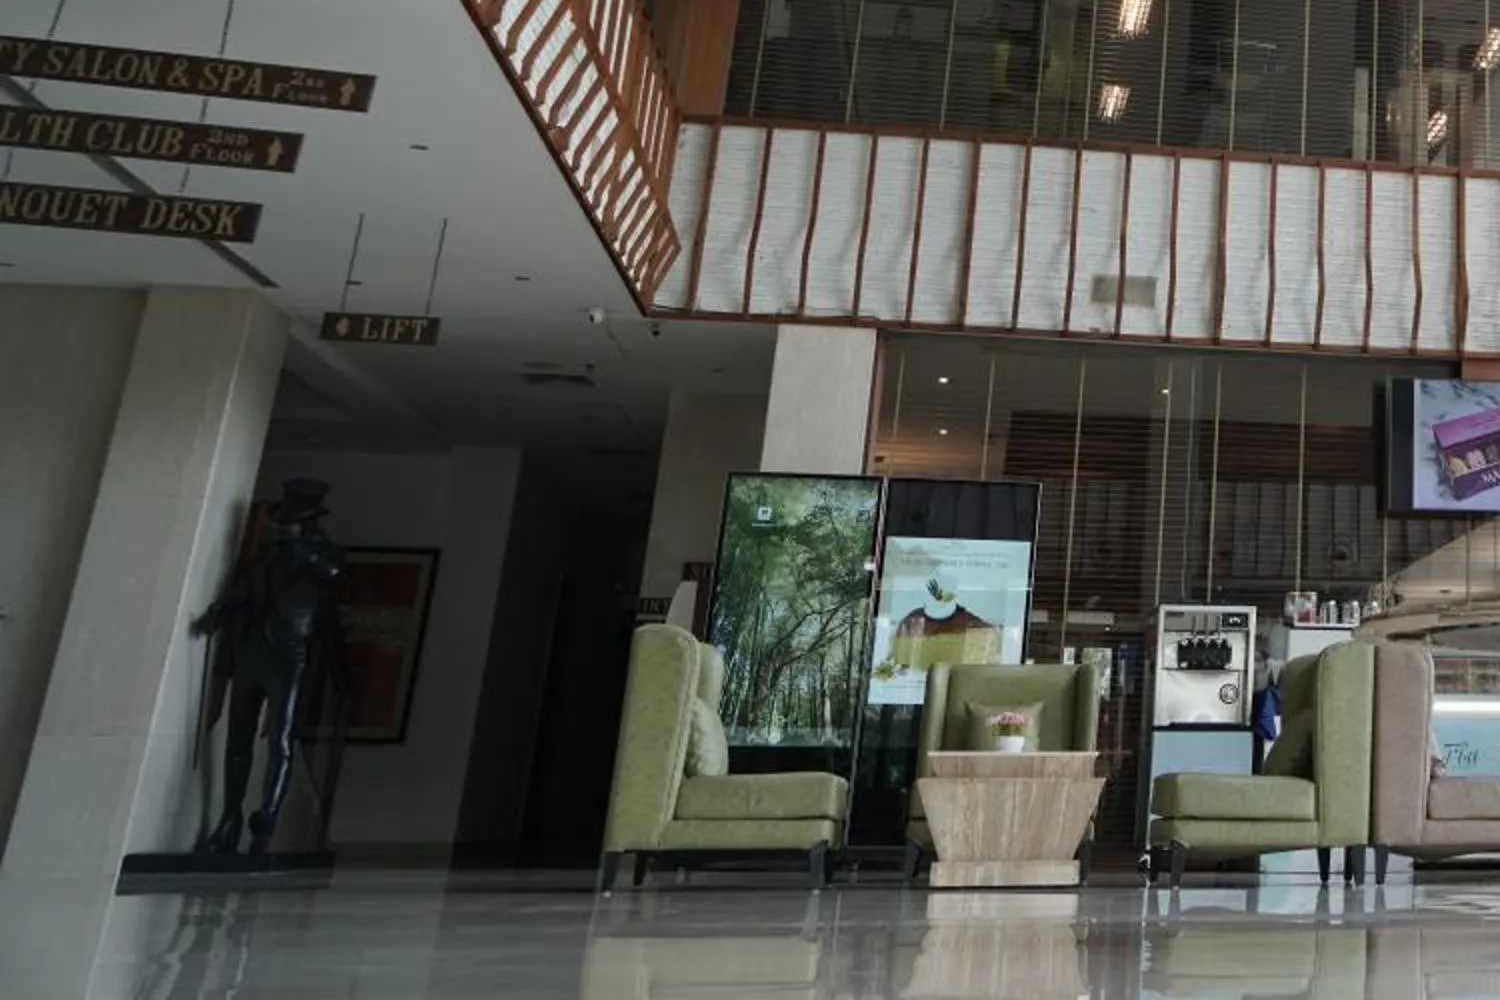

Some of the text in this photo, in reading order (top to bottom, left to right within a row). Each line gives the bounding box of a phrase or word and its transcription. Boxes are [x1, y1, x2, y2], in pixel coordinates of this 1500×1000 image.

[44, 47, 162, 83] SALON
[166, 59, 190, 88] &
[198, 62, 264, 96] SPA
[86, 120, 183, 156] CLUB
[205, 129, 249, 146] 2ND
[141, 200, 242, 235] DESK
[361, 316, 428, 342] LIFT
